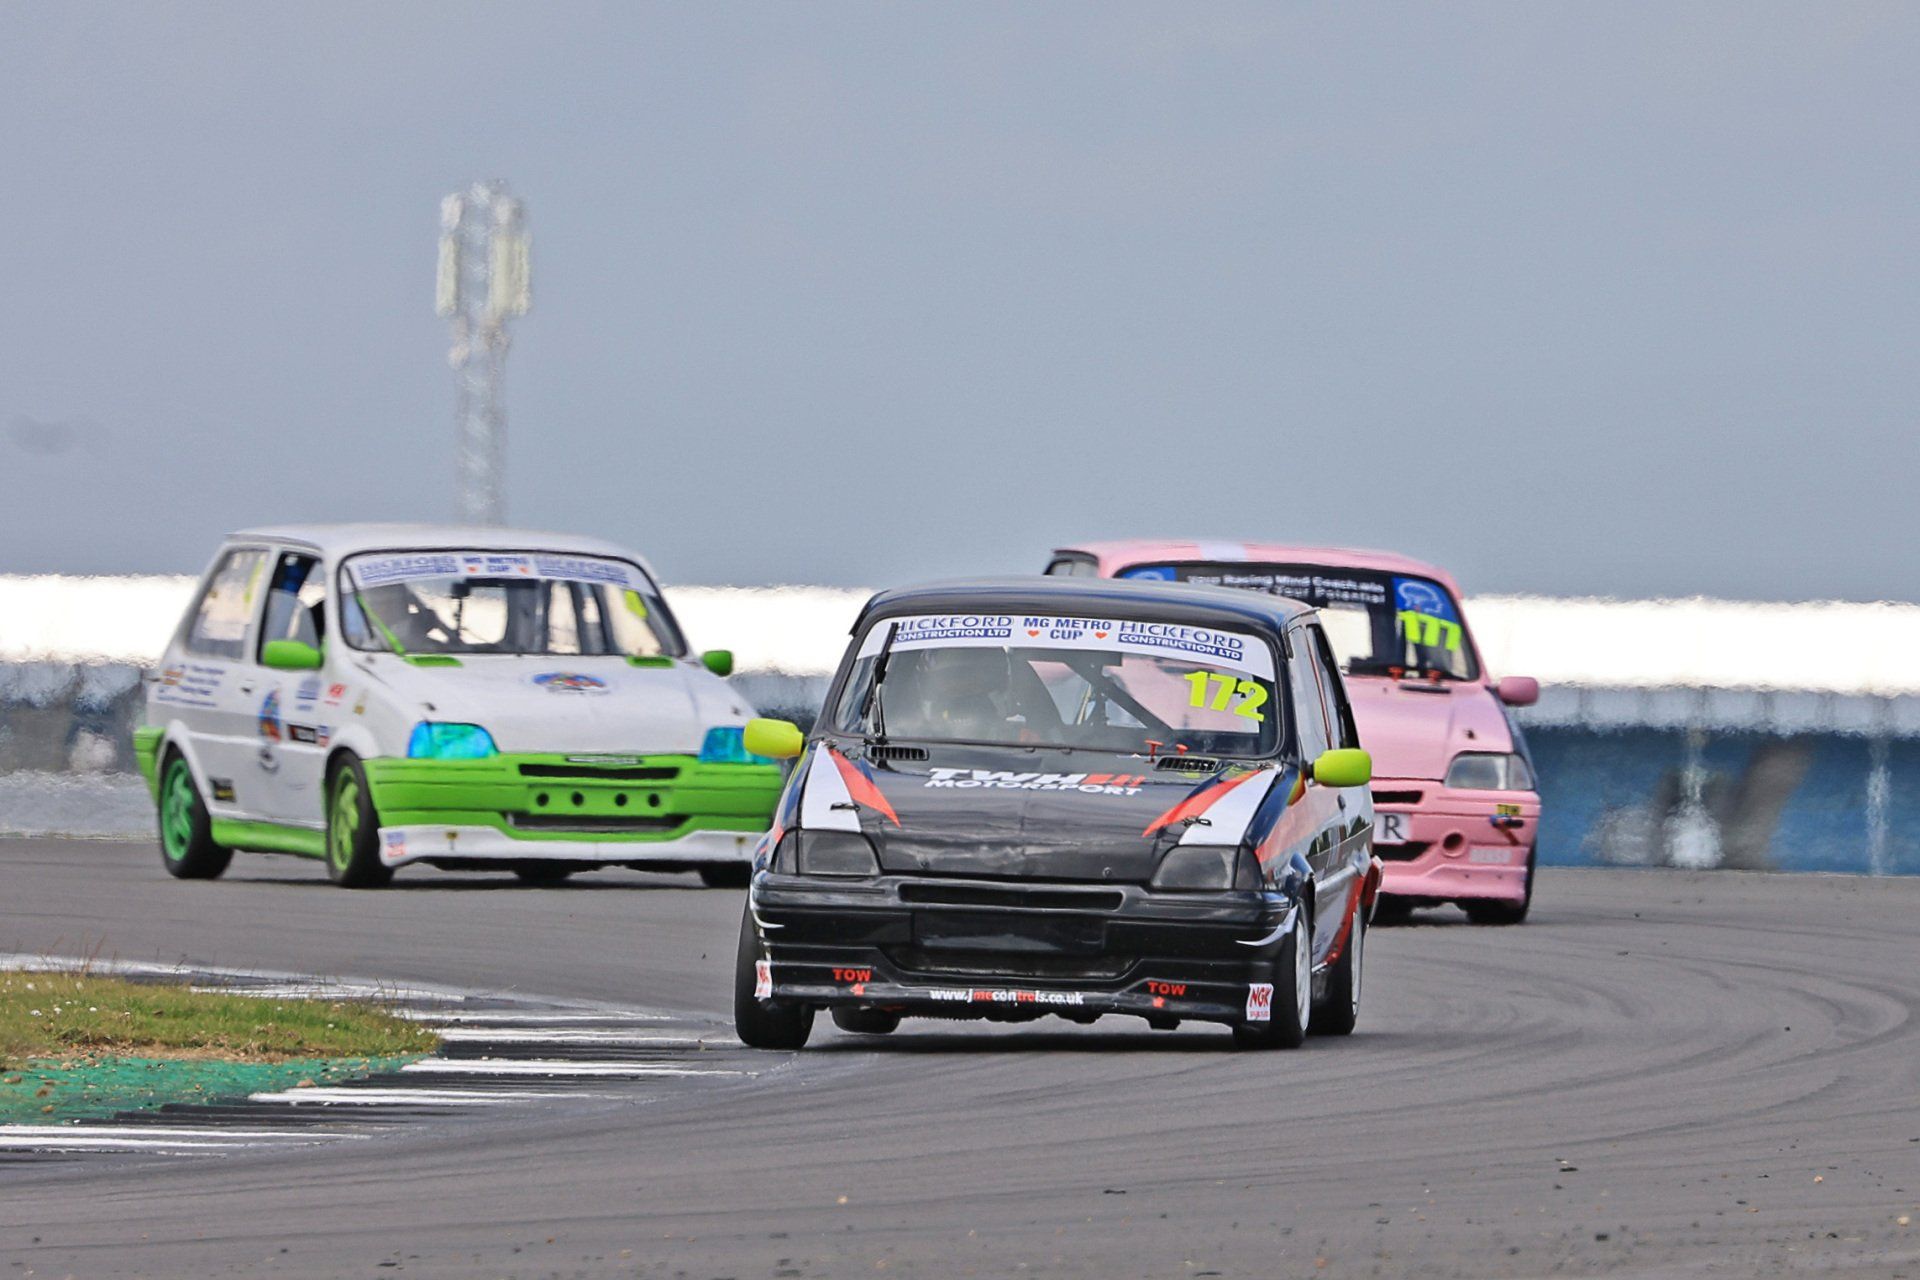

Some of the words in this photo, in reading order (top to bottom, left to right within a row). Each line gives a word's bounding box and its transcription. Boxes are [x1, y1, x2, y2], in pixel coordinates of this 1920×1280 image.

[1023, 617, 1051, 628] MG
[1055, 618, 1112, 631] METRO
[987, 628, 1009, 637] LTD
[1050, 629, 1083, 640] CUP
[1120, 621, 1243, 649] HICKFORD
[1120, 634, 1216, 653] CONSTRUCTION
[1218, 649, 1241, 659] LTD
[1184, 671, 1268, 722] 172
[924, 780, 1143, 796] MOTORSPORT
[832, 968, 872, 982] TOW
[1148, 982, 1186, 996] TOW
[1249, 986, 1272, 1008] NGK
